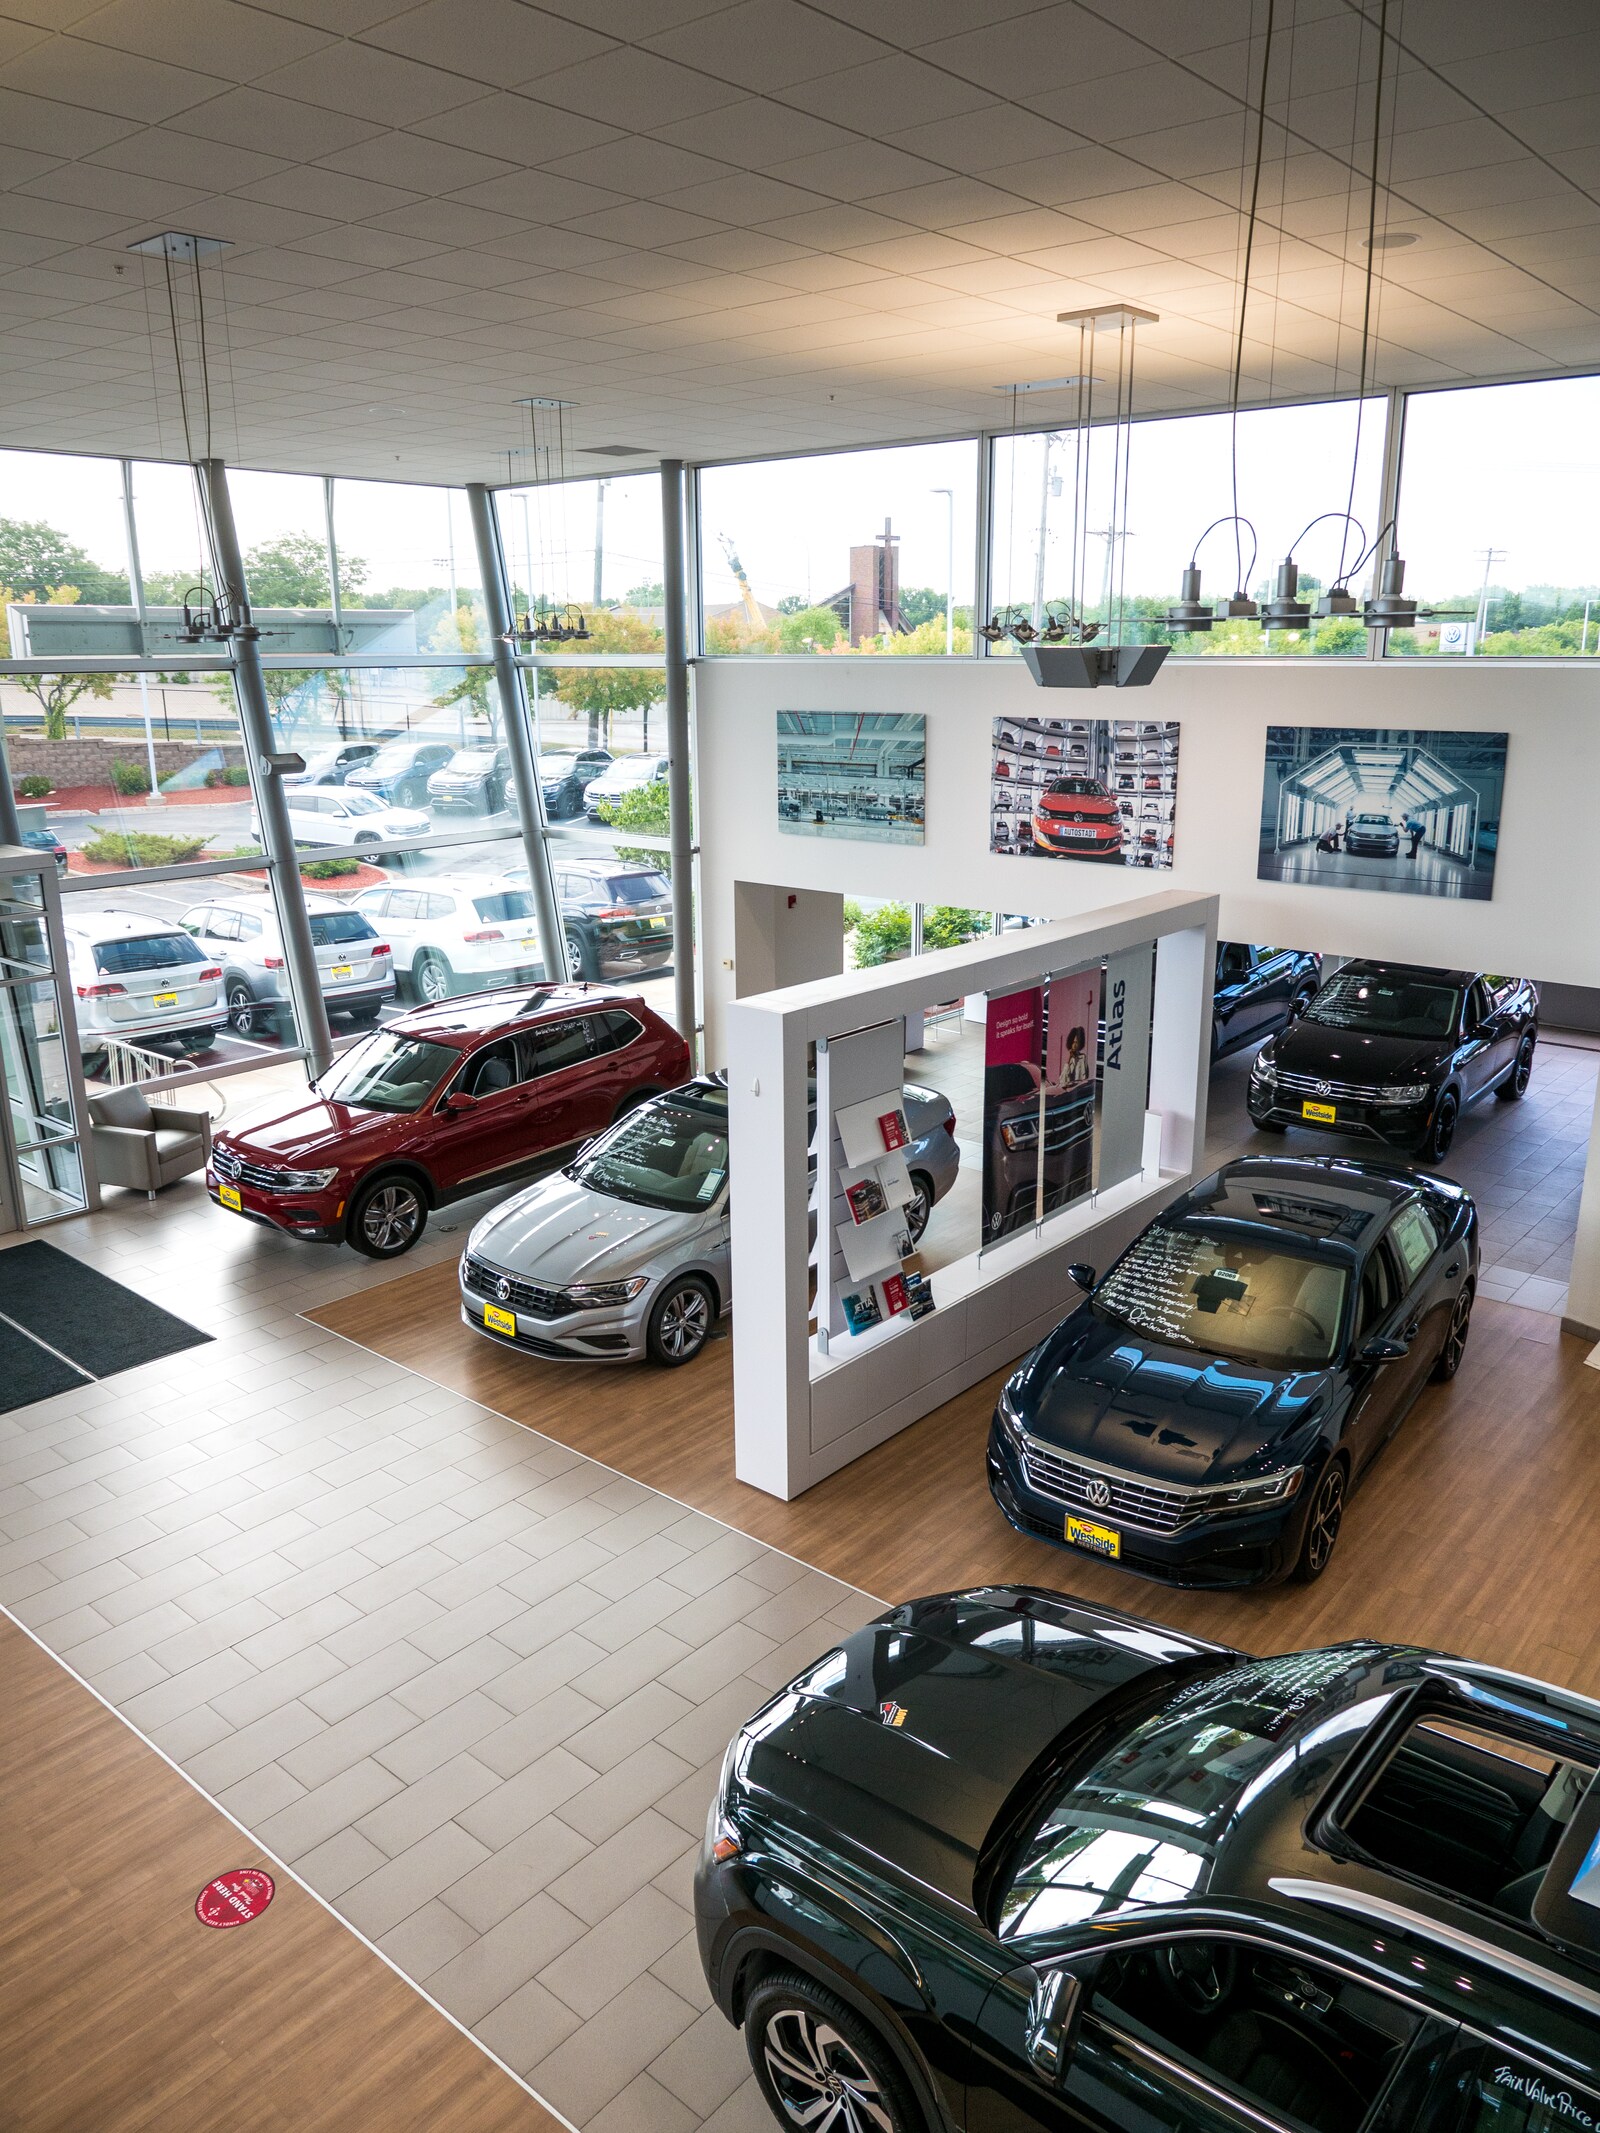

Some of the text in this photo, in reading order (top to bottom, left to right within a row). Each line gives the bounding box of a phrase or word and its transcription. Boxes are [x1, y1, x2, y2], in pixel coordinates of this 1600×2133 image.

[1064, 828, 1096, 838] AUTOSTADT
[995, 1019, 1012, 1030] Design
[1018, 1012, 1029, 1022] bold
[1000, 1027, 1016, 1038] speaks
[1015, 1024, 1023, 1032] for
[1107, 980, 1126, 1071] Atlas
[1305, 1109, 1333, 1120] Westside
[487, 1313, 513, 1332] Westside
[1070, 1526, 1116, 1552] Westside
[197, 1890, 209, 1911] DISTANCE
[212, 1880, 254, 1919] STAND HERE
[231, 1882, 254, 1905] Thank You
[1557, 2091, 1593, 2127] Price
